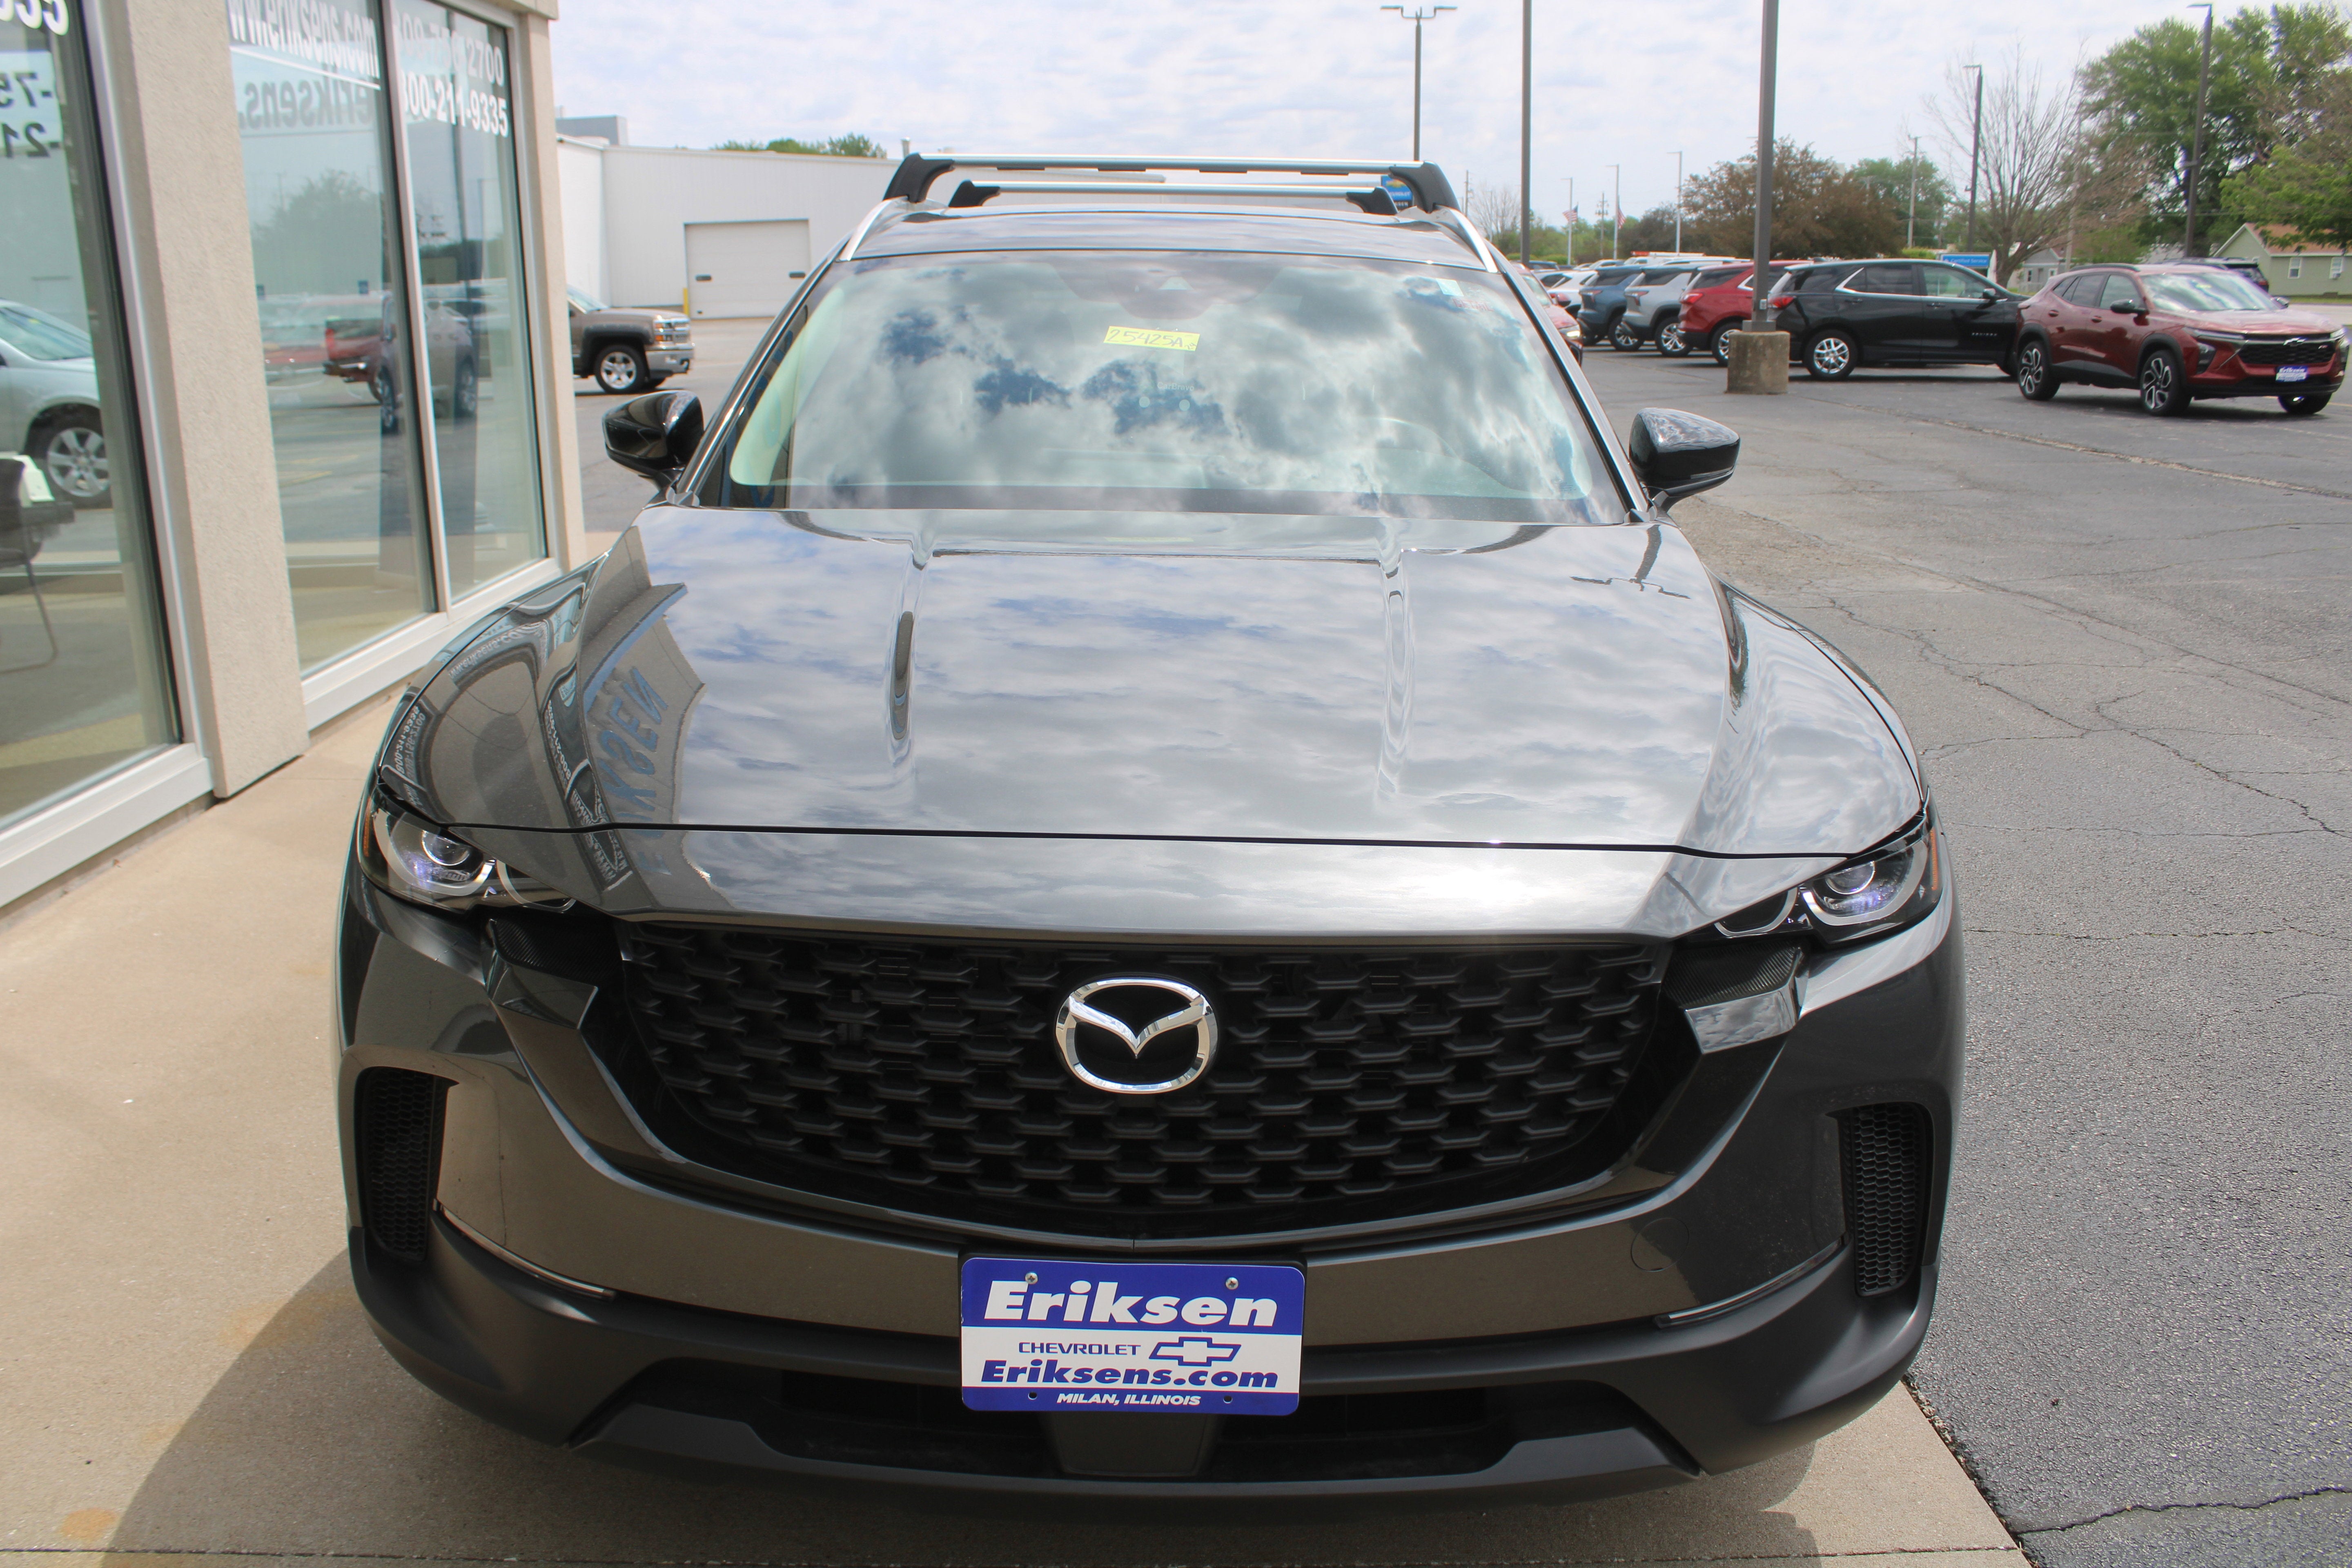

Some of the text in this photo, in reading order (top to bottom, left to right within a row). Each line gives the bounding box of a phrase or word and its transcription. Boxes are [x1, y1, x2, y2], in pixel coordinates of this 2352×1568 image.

[1107, 329, 1183, 347] 25425A
[1157, 381, 1195, 391] CarBravo
[984, 1280, 1277, 1326] Eriksen
[1018, 1342, 1141, 1356] CHEVROLET
[981, 1359, 1278, 1388] Eriksens.com
[1056, 1392, 1201, 1406] MILAN, ILLINOIS
